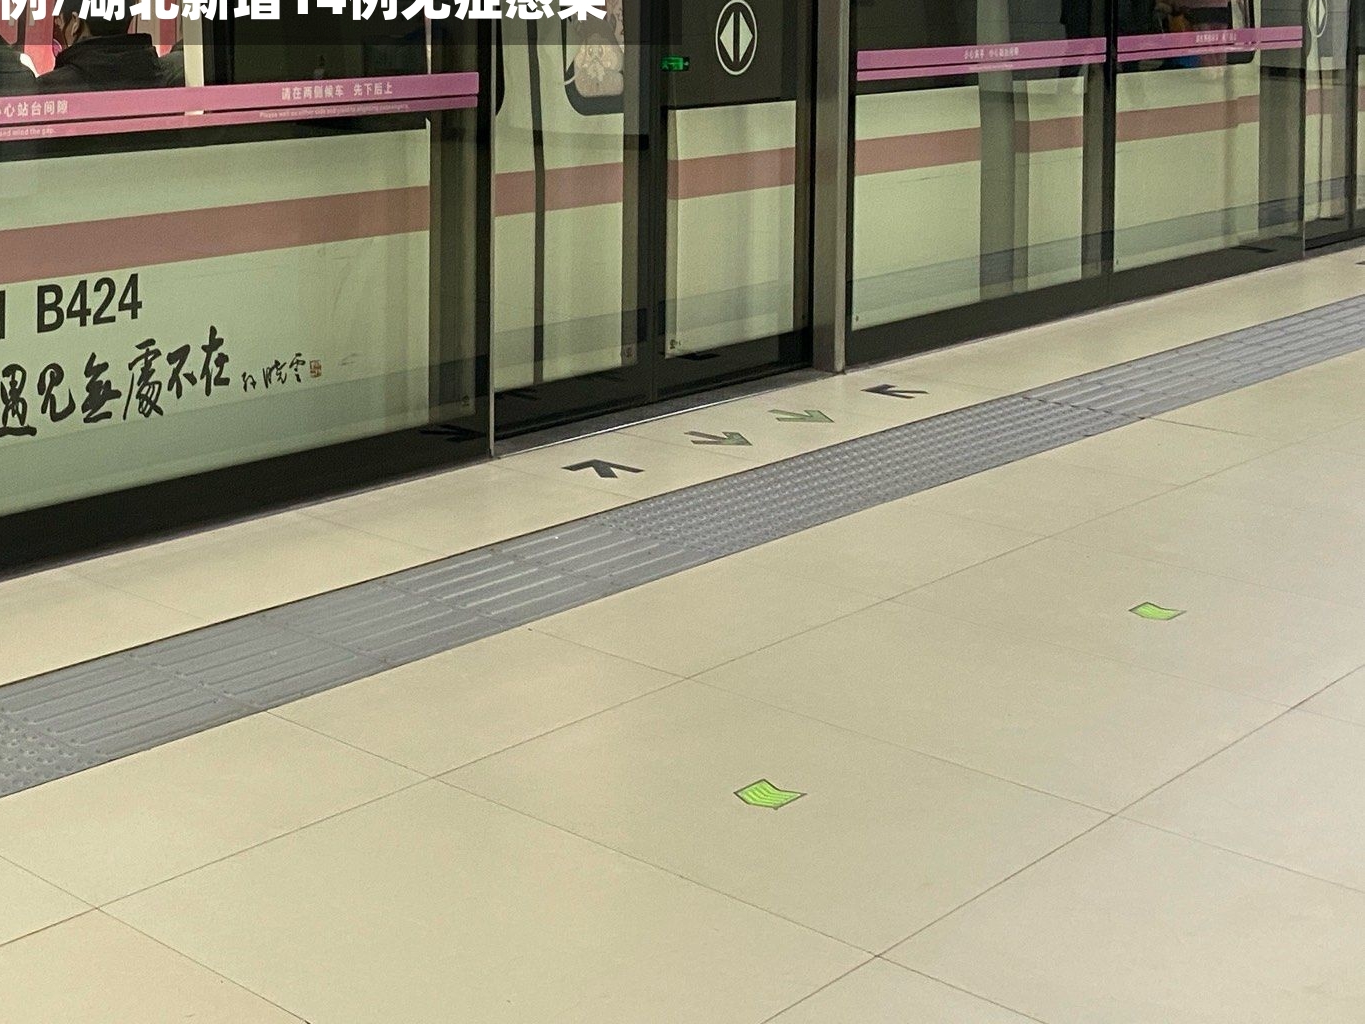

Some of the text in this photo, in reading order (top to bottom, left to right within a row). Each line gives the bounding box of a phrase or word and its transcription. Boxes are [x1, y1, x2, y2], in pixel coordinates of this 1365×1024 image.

[281, 82, 393, 101] 请在两侧候车 先下后上
[37, 273, 143, 334] B424
